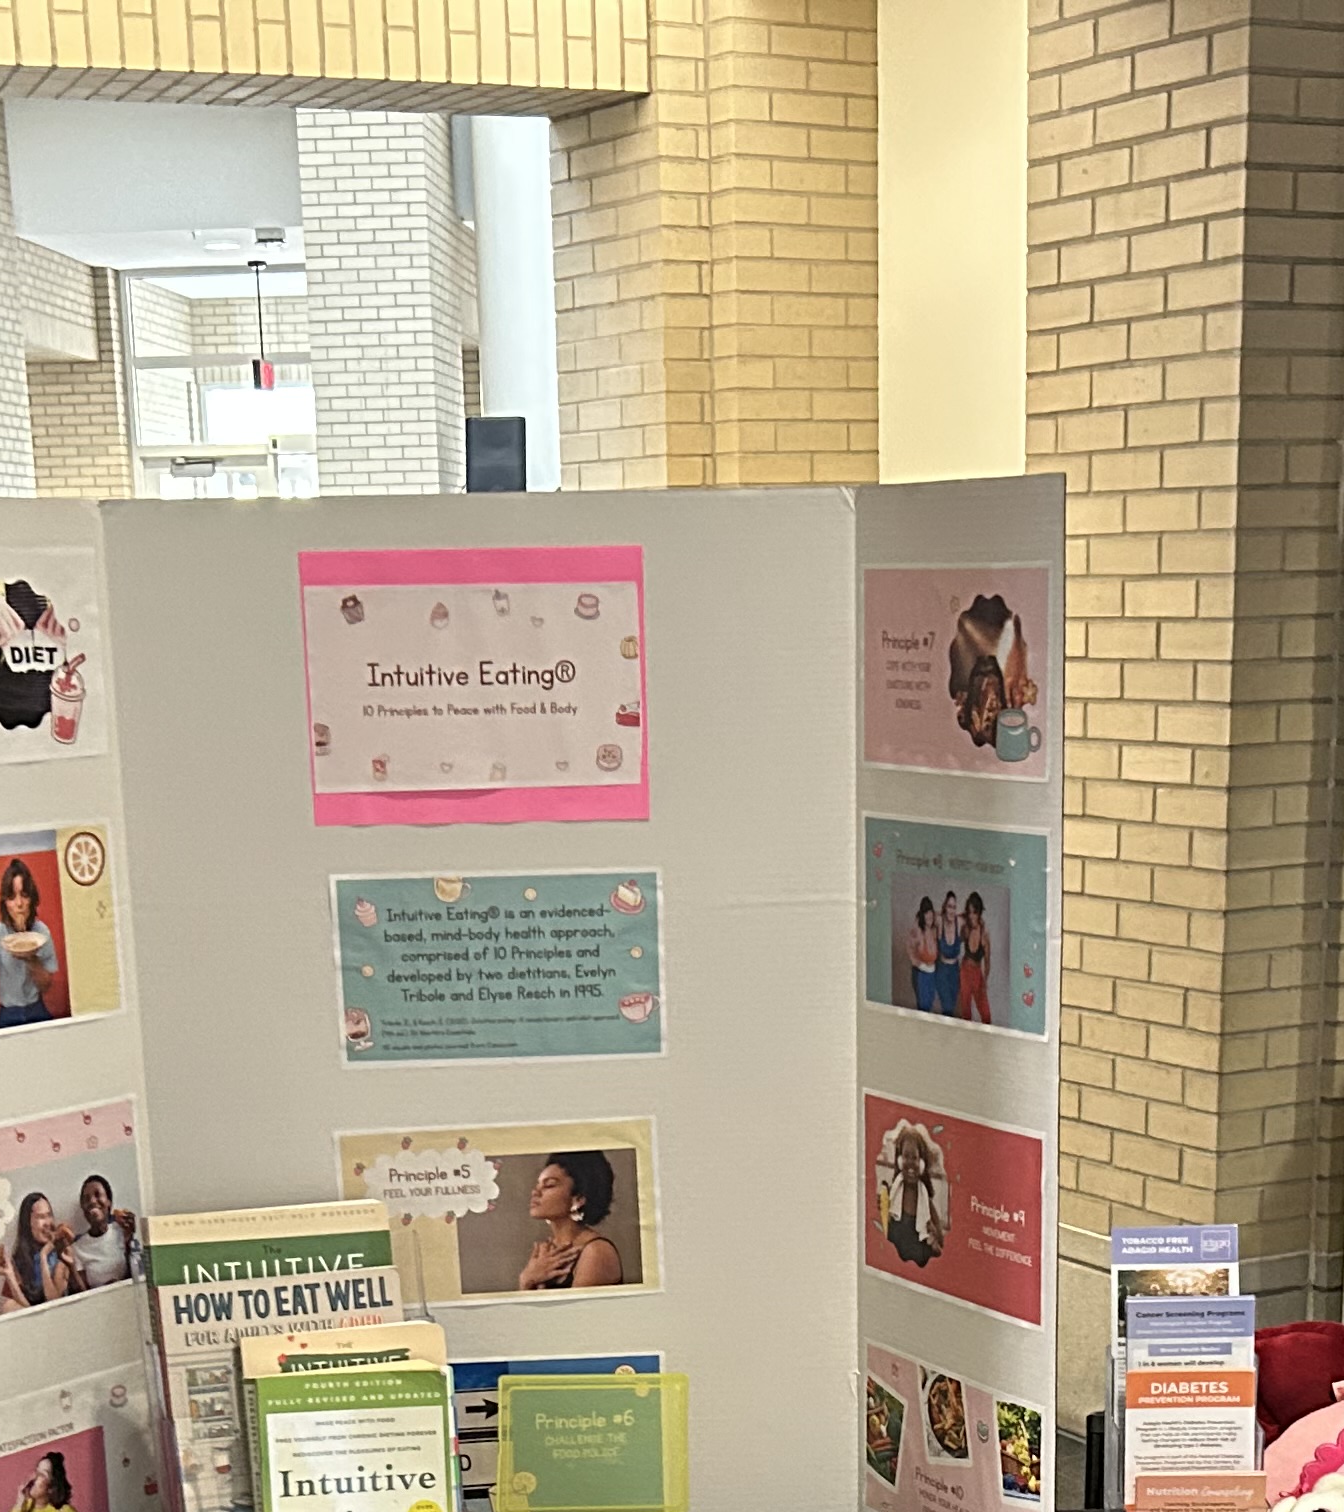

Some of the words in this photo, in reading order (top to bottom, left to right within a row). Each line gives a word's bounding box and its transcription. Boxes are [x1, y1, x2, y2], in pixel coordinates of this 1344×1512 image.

[882, 629, 919, 653] Principle
[10, 646, 58, 665] DIET
[366, 662, 469, 687] Intuitive
[478, 659, 577, 691] Eating®
[362, 705, 374, 717] 10
[377, 703, 429, 720] Principles
[432, 704, 444, 716] to
[446, 703, 480, 716] Peace
[483, 703, 508, 716] with
[510, 702, 537, 715] Food
[539, 702, 547, 714] &
[549, 701, 578, 718] Body
[386, 907, 443, 923] Intuitive
[446, 906, 501, 924] Eating®
[504, 909, 515, 920] is
[519, 909, 536, 919] an
[539, 904, 611, 918] evidenced-
[383, 930, 427, 944] based,
[430, 926, 501, 943] mind-body
[505, 925, 546, 939] health
[400, 948, 470, 965] comprised
[473, 948, 489, 961] of
[492, 947, 507, 960] 10
[511, 945, 573, 962] Principles
[576, 945, 600, 959] and
[386, 968, 452, 985] developed
[455, 967, 473, 983] by
[478, 967, 503, 981] two
[575, 965, 617, 980] Evelyn
[401, 988, 446, 1002] Tribole
[450, 989, 474, 1001] and
[478, 987, 513, 1004] Elyse
[517, 985, 556, 1000] Resch
[559, 986, 571, 998] in
[389, 1166, 448, 1185] Principle
[453, 1164, 471, 1179] #5
[382, 1187, 407, 1199] FEEL
[408, 1186, 433, 1198] YOUR
[434, 1184, 481, 1196] FULLNESS
[971, 1195, 1010, 1223] Principle
[1013, 1210, 1025, 1228] #9
[1158, 1246, 1193, 1254] HEALTH
[173, 1287, 234, 1324] HOW
[238, 1286, 270, 1319] TO
[274, 1282, 321, 1316] EAT
[325, 1276, 394, 1312] WELL
[1165, 1311, 1205, 1319] Screening
[185, 1331, 220, 1347] FOR
[1197, 1360, 1225, 1368] develop
[305, 1382, 349, 1390] FOURTH
[355, 1379, 402, 1387] EDITION
[1150, 1381, 1229, 1395] DIABETES
[308, 1395, 356, 1404] REVISED
[390, 1392, 441, 1400] UPDATED
[1138, 1396, 1194, 1404] PREVENTION
[1195, 1395, 1240, 1403] PROGRAM
[536, 1411, 607, 1431] Principle
[613, 1409, 635, 1426] #6
[278, 1464, 436, 1498] Intuitive
[915, 1466, 948, 1493] Principle
[1146, 1487, 1198, 1496] Nutrition
